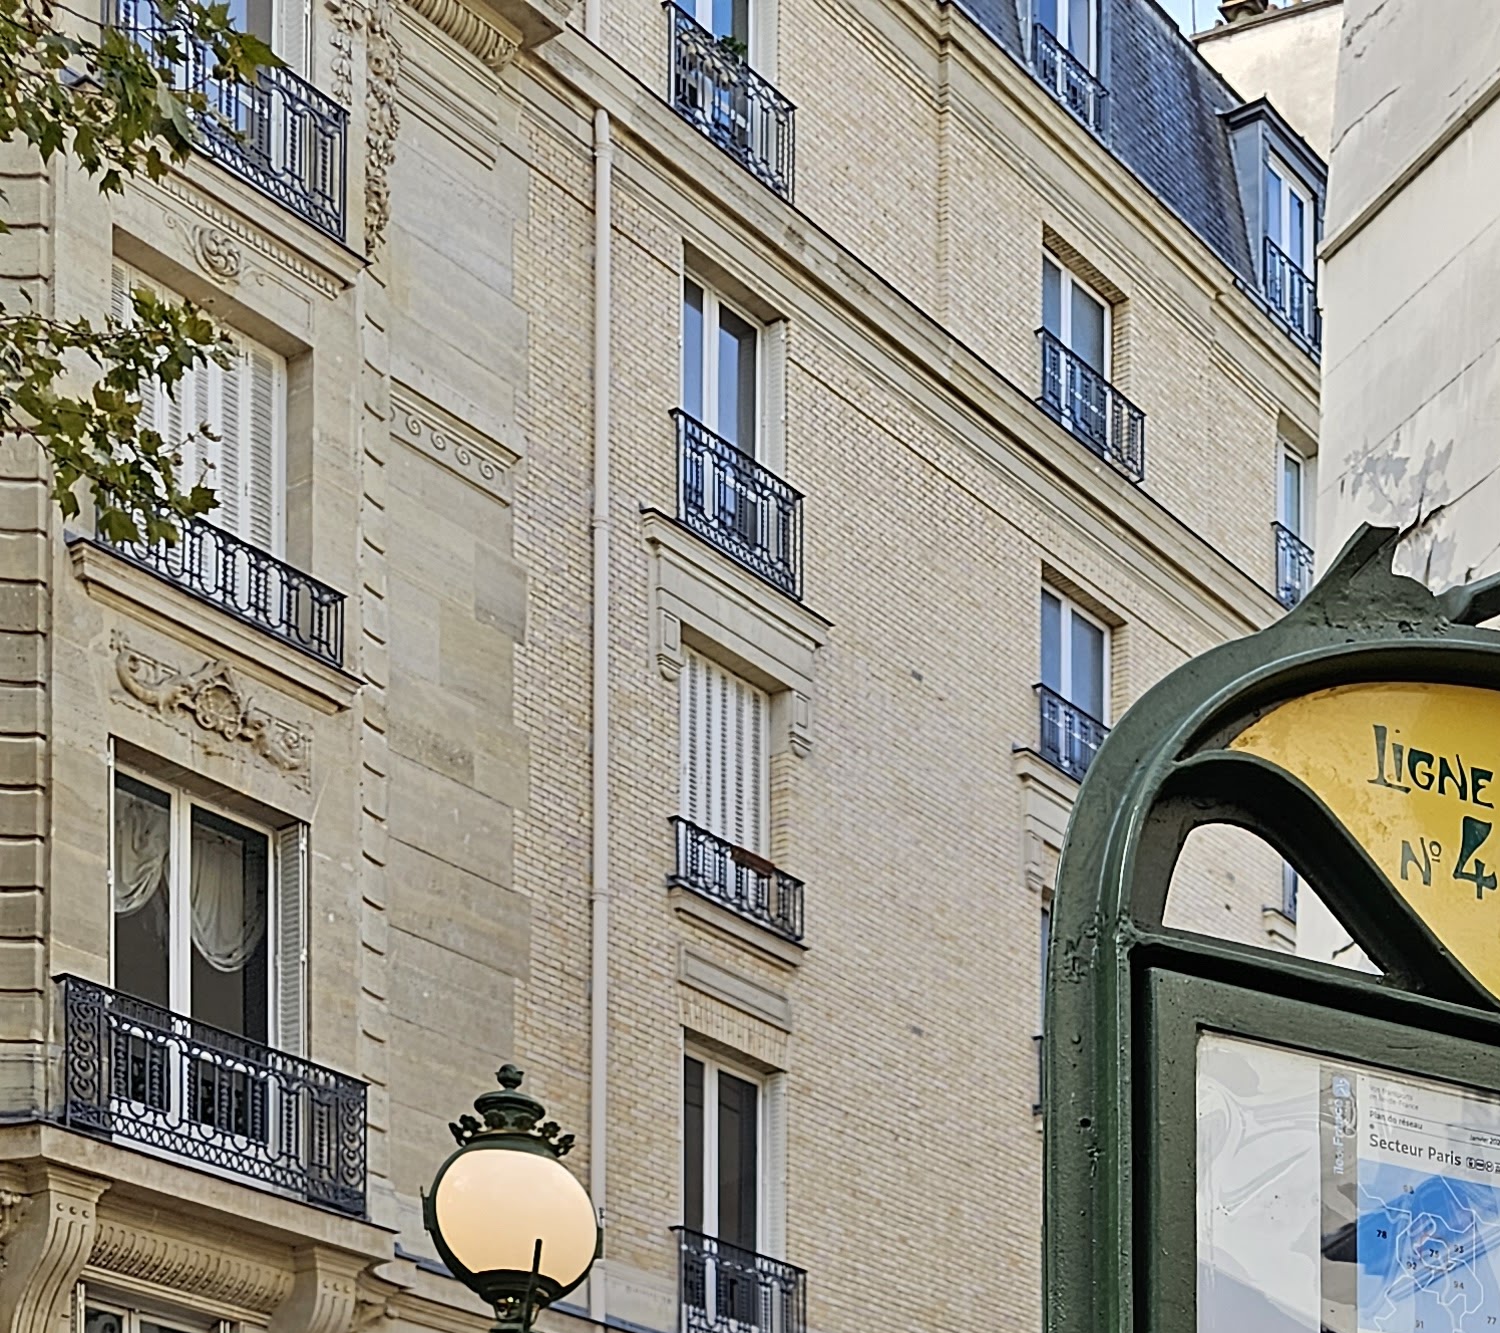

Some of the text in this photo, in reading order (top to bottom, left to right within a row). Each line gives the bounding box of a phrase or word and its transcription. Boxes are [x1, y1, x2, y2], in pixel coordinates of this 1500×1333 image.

[1453, 816, 1498, 900] 4
[1369, 1110, 1386, 1122] Plan
[1398, 1117, 1424, 1131] réseau
[1369, 1134, 1463, 1166] Secteur Paris
[1376, 1229, 1388, 1240] 78
[1406, 1261, 1417, 1271] 92
[1487, 1316, 1497, 1325] 77
